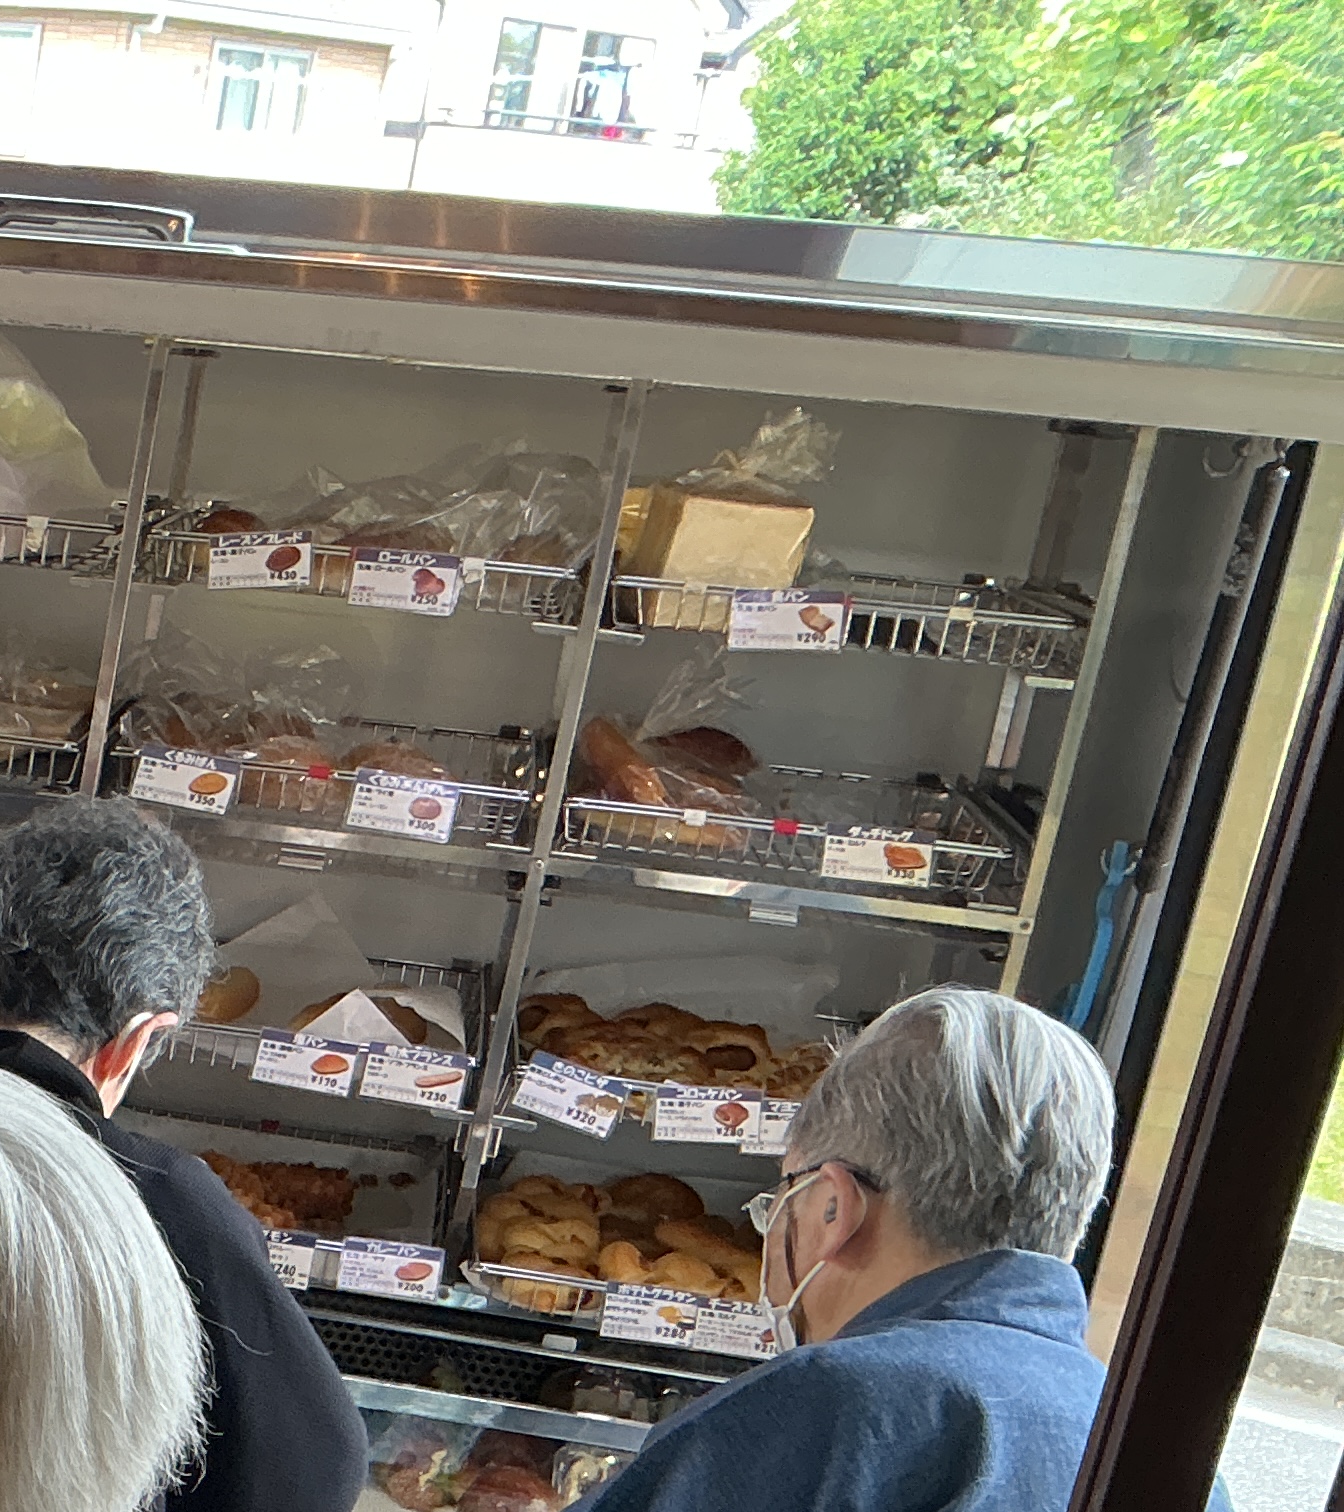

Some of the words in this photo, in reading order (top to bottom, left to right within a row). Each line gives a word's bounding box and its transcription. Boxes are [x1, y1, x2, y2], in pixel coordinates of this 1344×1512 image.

[218, 531, 302, 547] レーズンブレッド
[377, 550, 436, 566] ロールパン
[676, 1086, 742, 1101] コロッケパン
[366, 1241, 420, 1258] カレーパン
